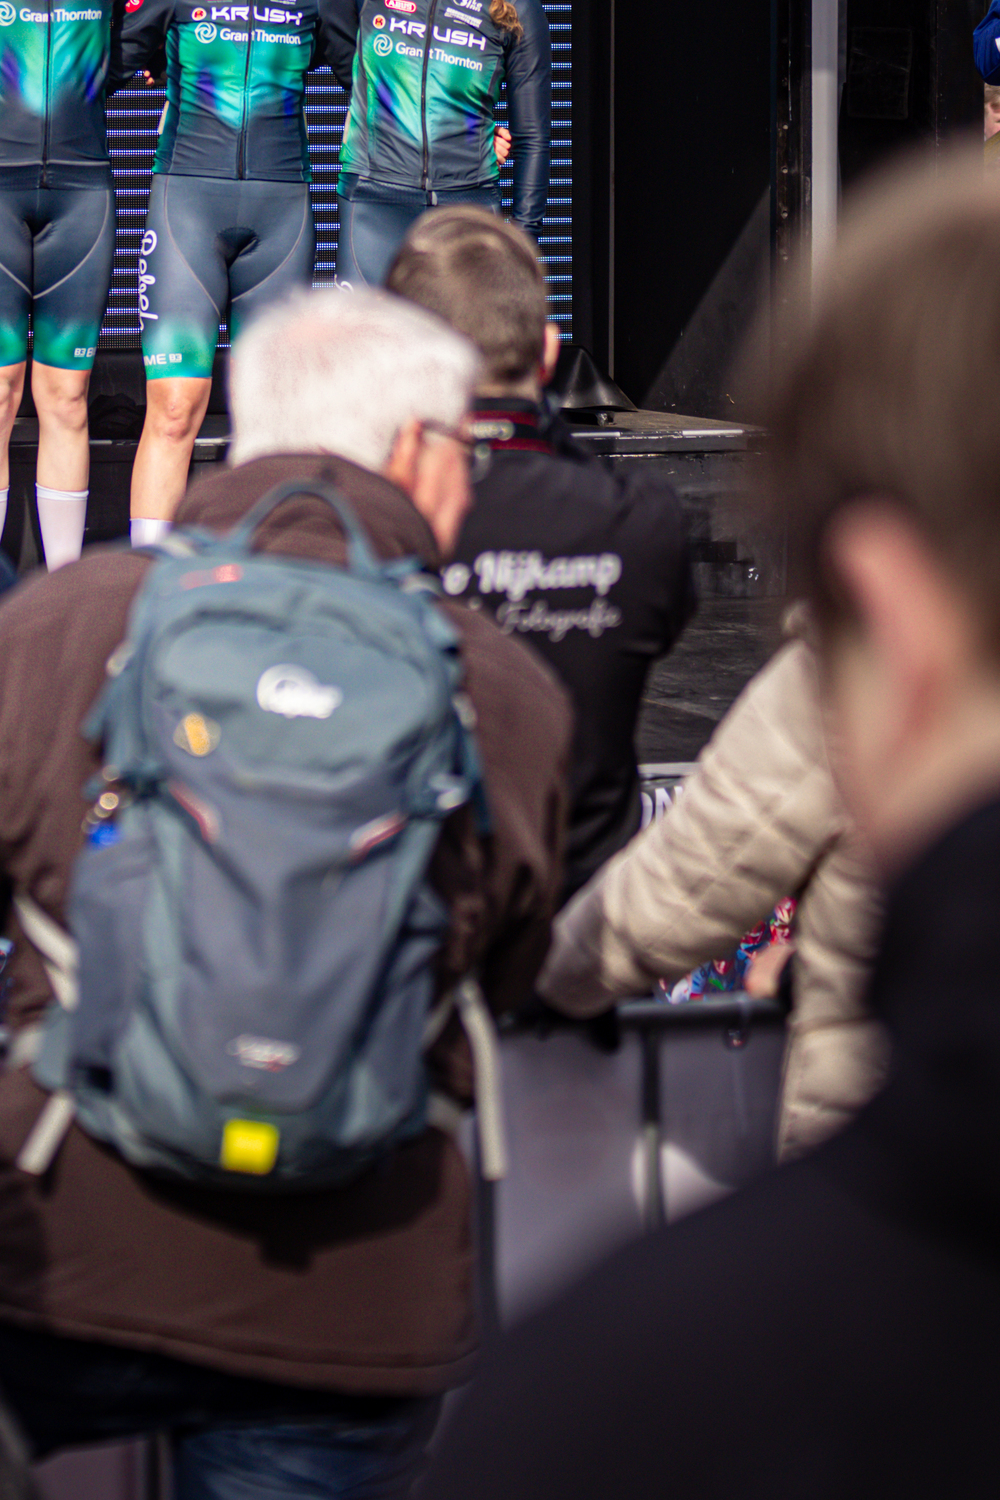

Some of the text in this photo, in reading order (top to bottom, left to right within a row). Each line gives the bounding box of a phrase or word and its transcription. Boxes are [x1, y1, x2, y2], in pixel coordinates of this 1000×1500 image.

[54, 9, 102, 22] Thornton
[211, 6, 303, 25] KRUSH
[255, 29, 301, 44] Thornton
[389, 17, 487, 50] KRUSH
[395, 42, 483, 71] Grant Thornton
